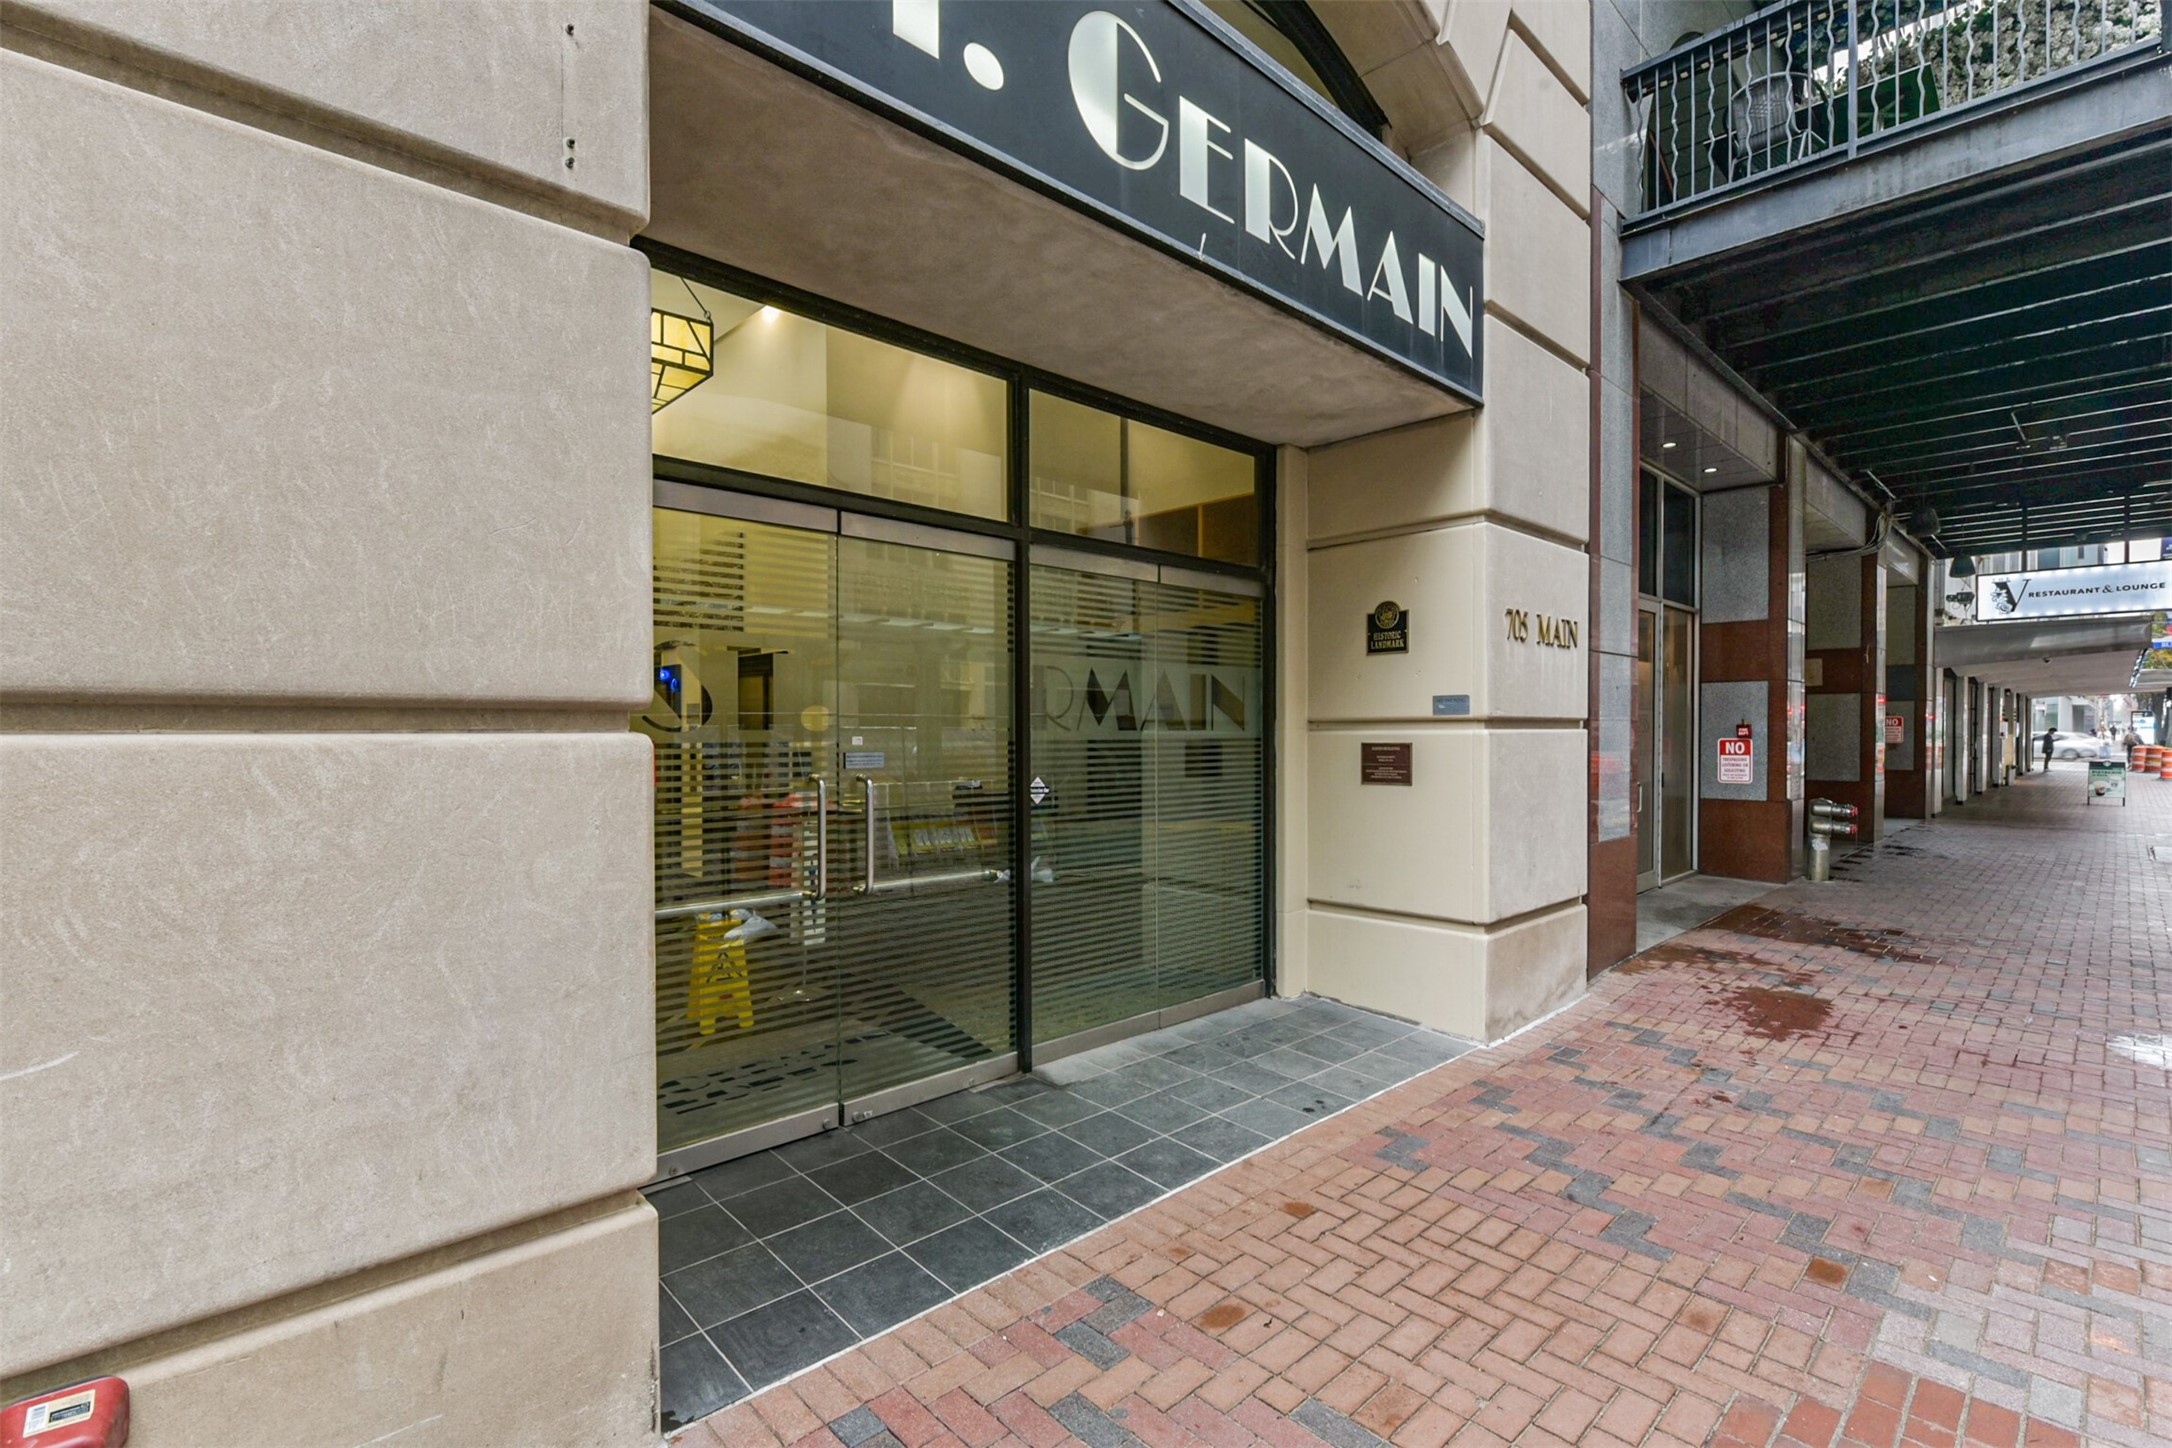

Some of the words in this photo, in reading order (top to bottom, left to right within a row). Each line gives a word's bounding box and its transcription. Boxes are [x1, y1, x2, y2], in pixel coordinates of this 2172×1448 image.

[1067, 9, 1474, 361] GERMAIN
[2028, 587, 2101, 598] RESTAURANT
[2102, 584, 2114, 594] &
[2116, 582, 2166, 592] LOUNGE
[1505, 608, 1529, 643] 705
[1536, 613, 1579, 649] MAIN
[1373, 631, 1402, 640] HISTORIC
[1370, 639, 1405, 650] LANDMARK
[1886, 718, 1899, 726] NO
[1725, 742, 1745, 754] NO
